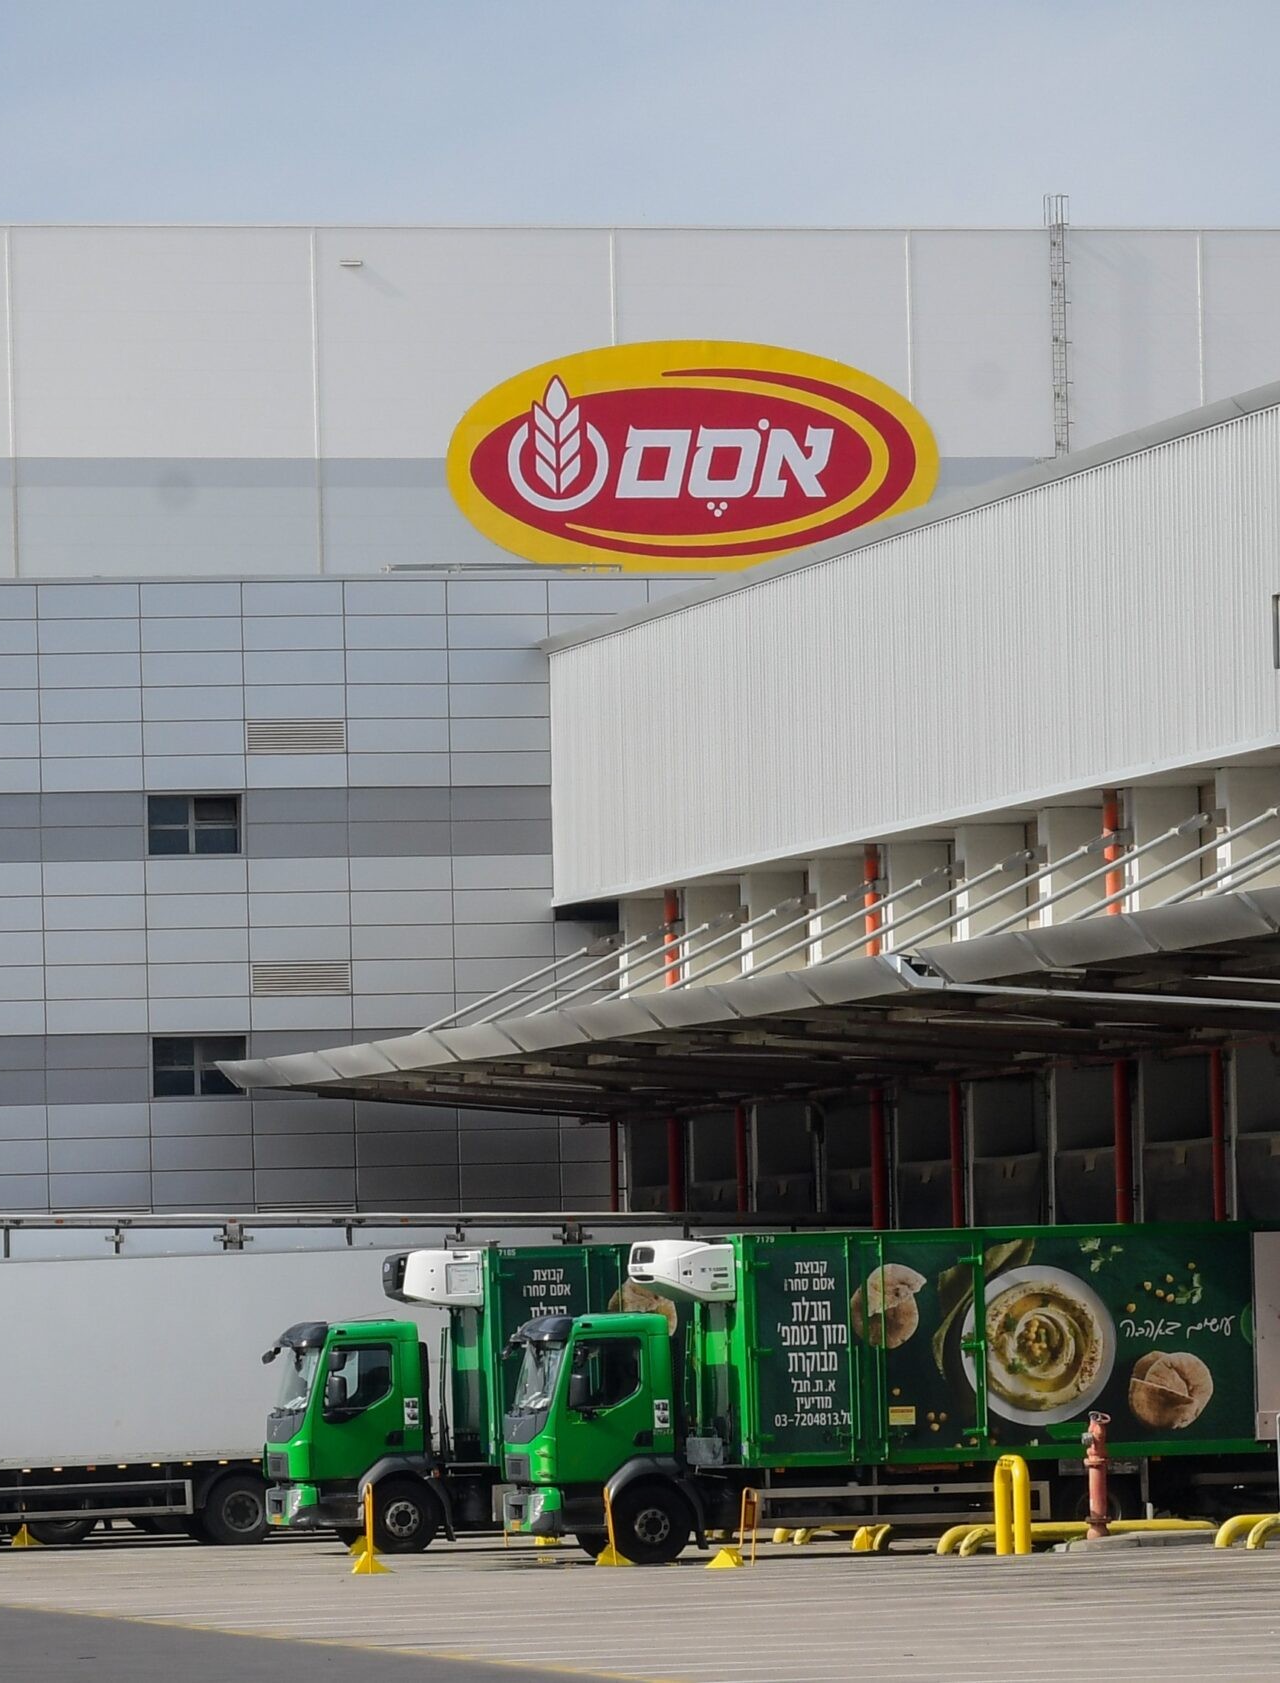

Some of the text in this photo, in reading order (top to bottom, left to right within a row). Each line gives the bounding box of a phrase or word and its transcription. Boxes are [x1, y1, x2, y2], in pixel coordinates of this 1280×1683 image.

[533, 1268, 564, 1283] קבוצת
[794, 1261, 827, 1276] קבוצת
[549, 1283, 571, 1296] אסם
[812, 1277, 835, 1291] אסם
[791, 1297, 831, 1322] הובלת
[822, 1324, 848, 1350] מזון
[1119, 1318, 1182, 1342] באהבה
[787, 1351, 838, 1377] מבוקרת
[791, 1377, 811, 1393] חבל
[795, 1396, 832, 1412] מודיעין
